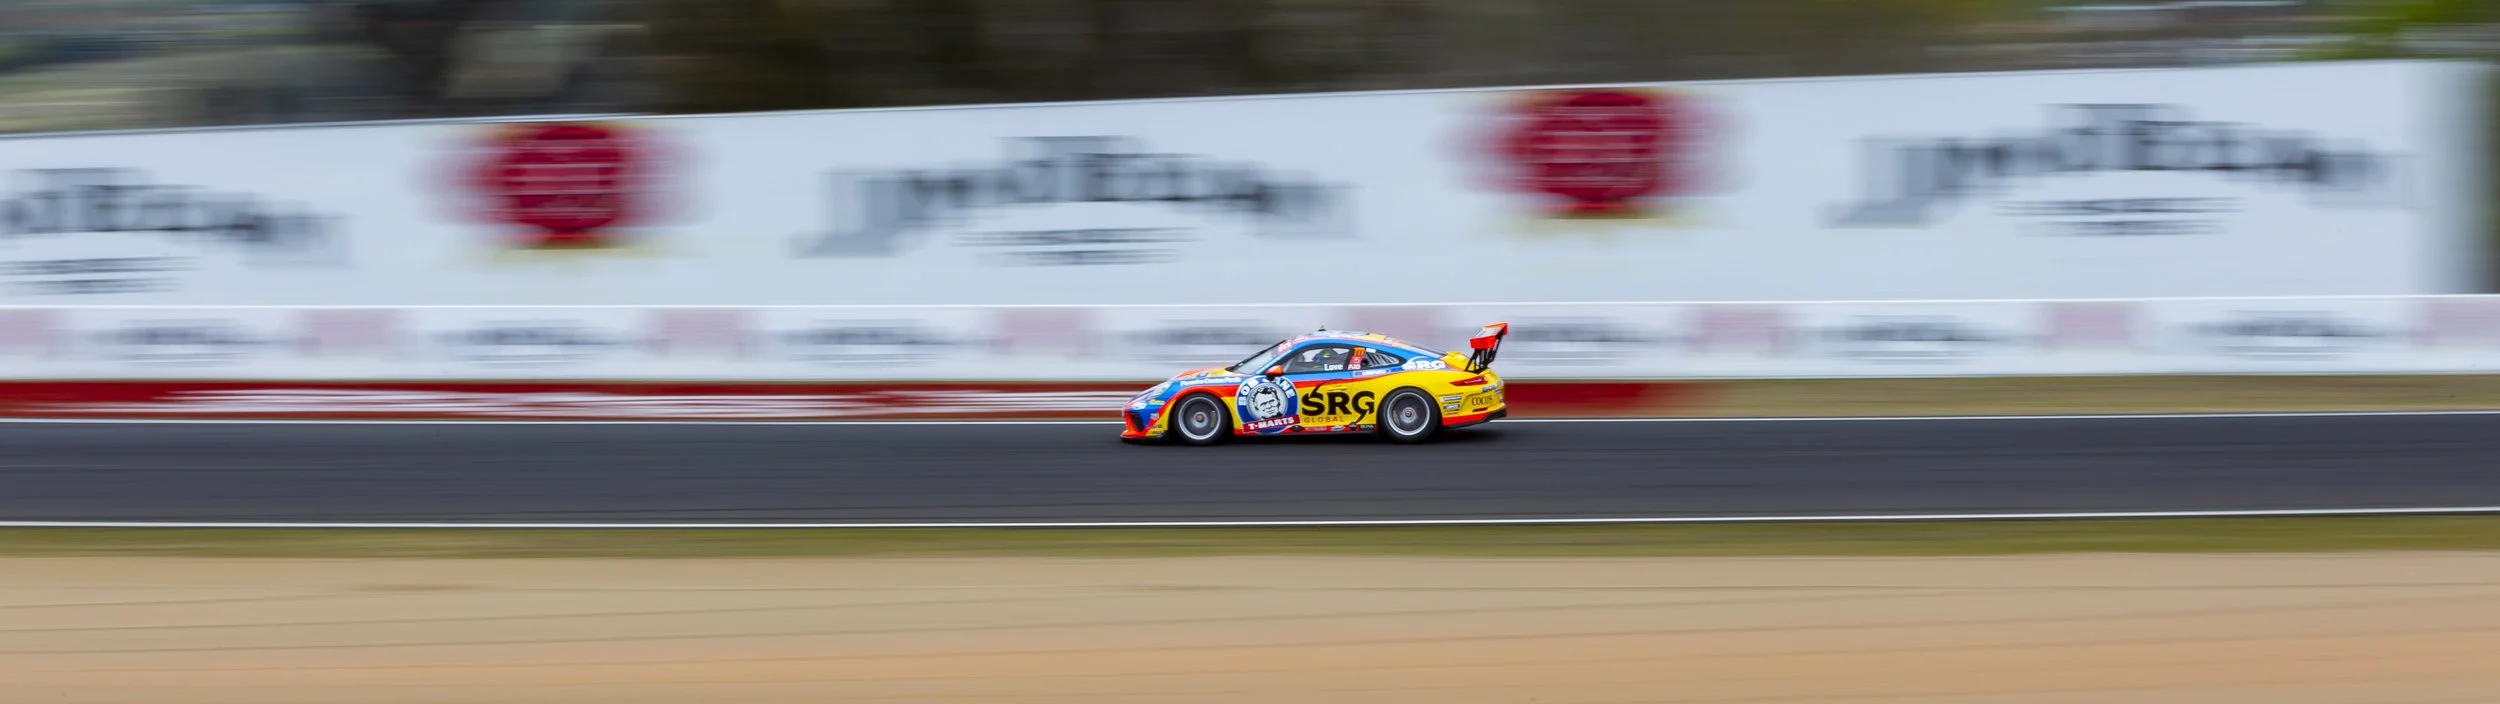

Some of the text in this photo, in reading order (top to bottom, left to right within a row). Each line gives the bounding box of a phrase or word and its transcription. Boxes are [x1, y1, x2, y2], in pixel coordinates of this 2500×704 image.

[1402, 356, 1447, 370] SRG
[1238, 378, 1259, 406] BOB
[1301, 384, 1375, 422] SRG
